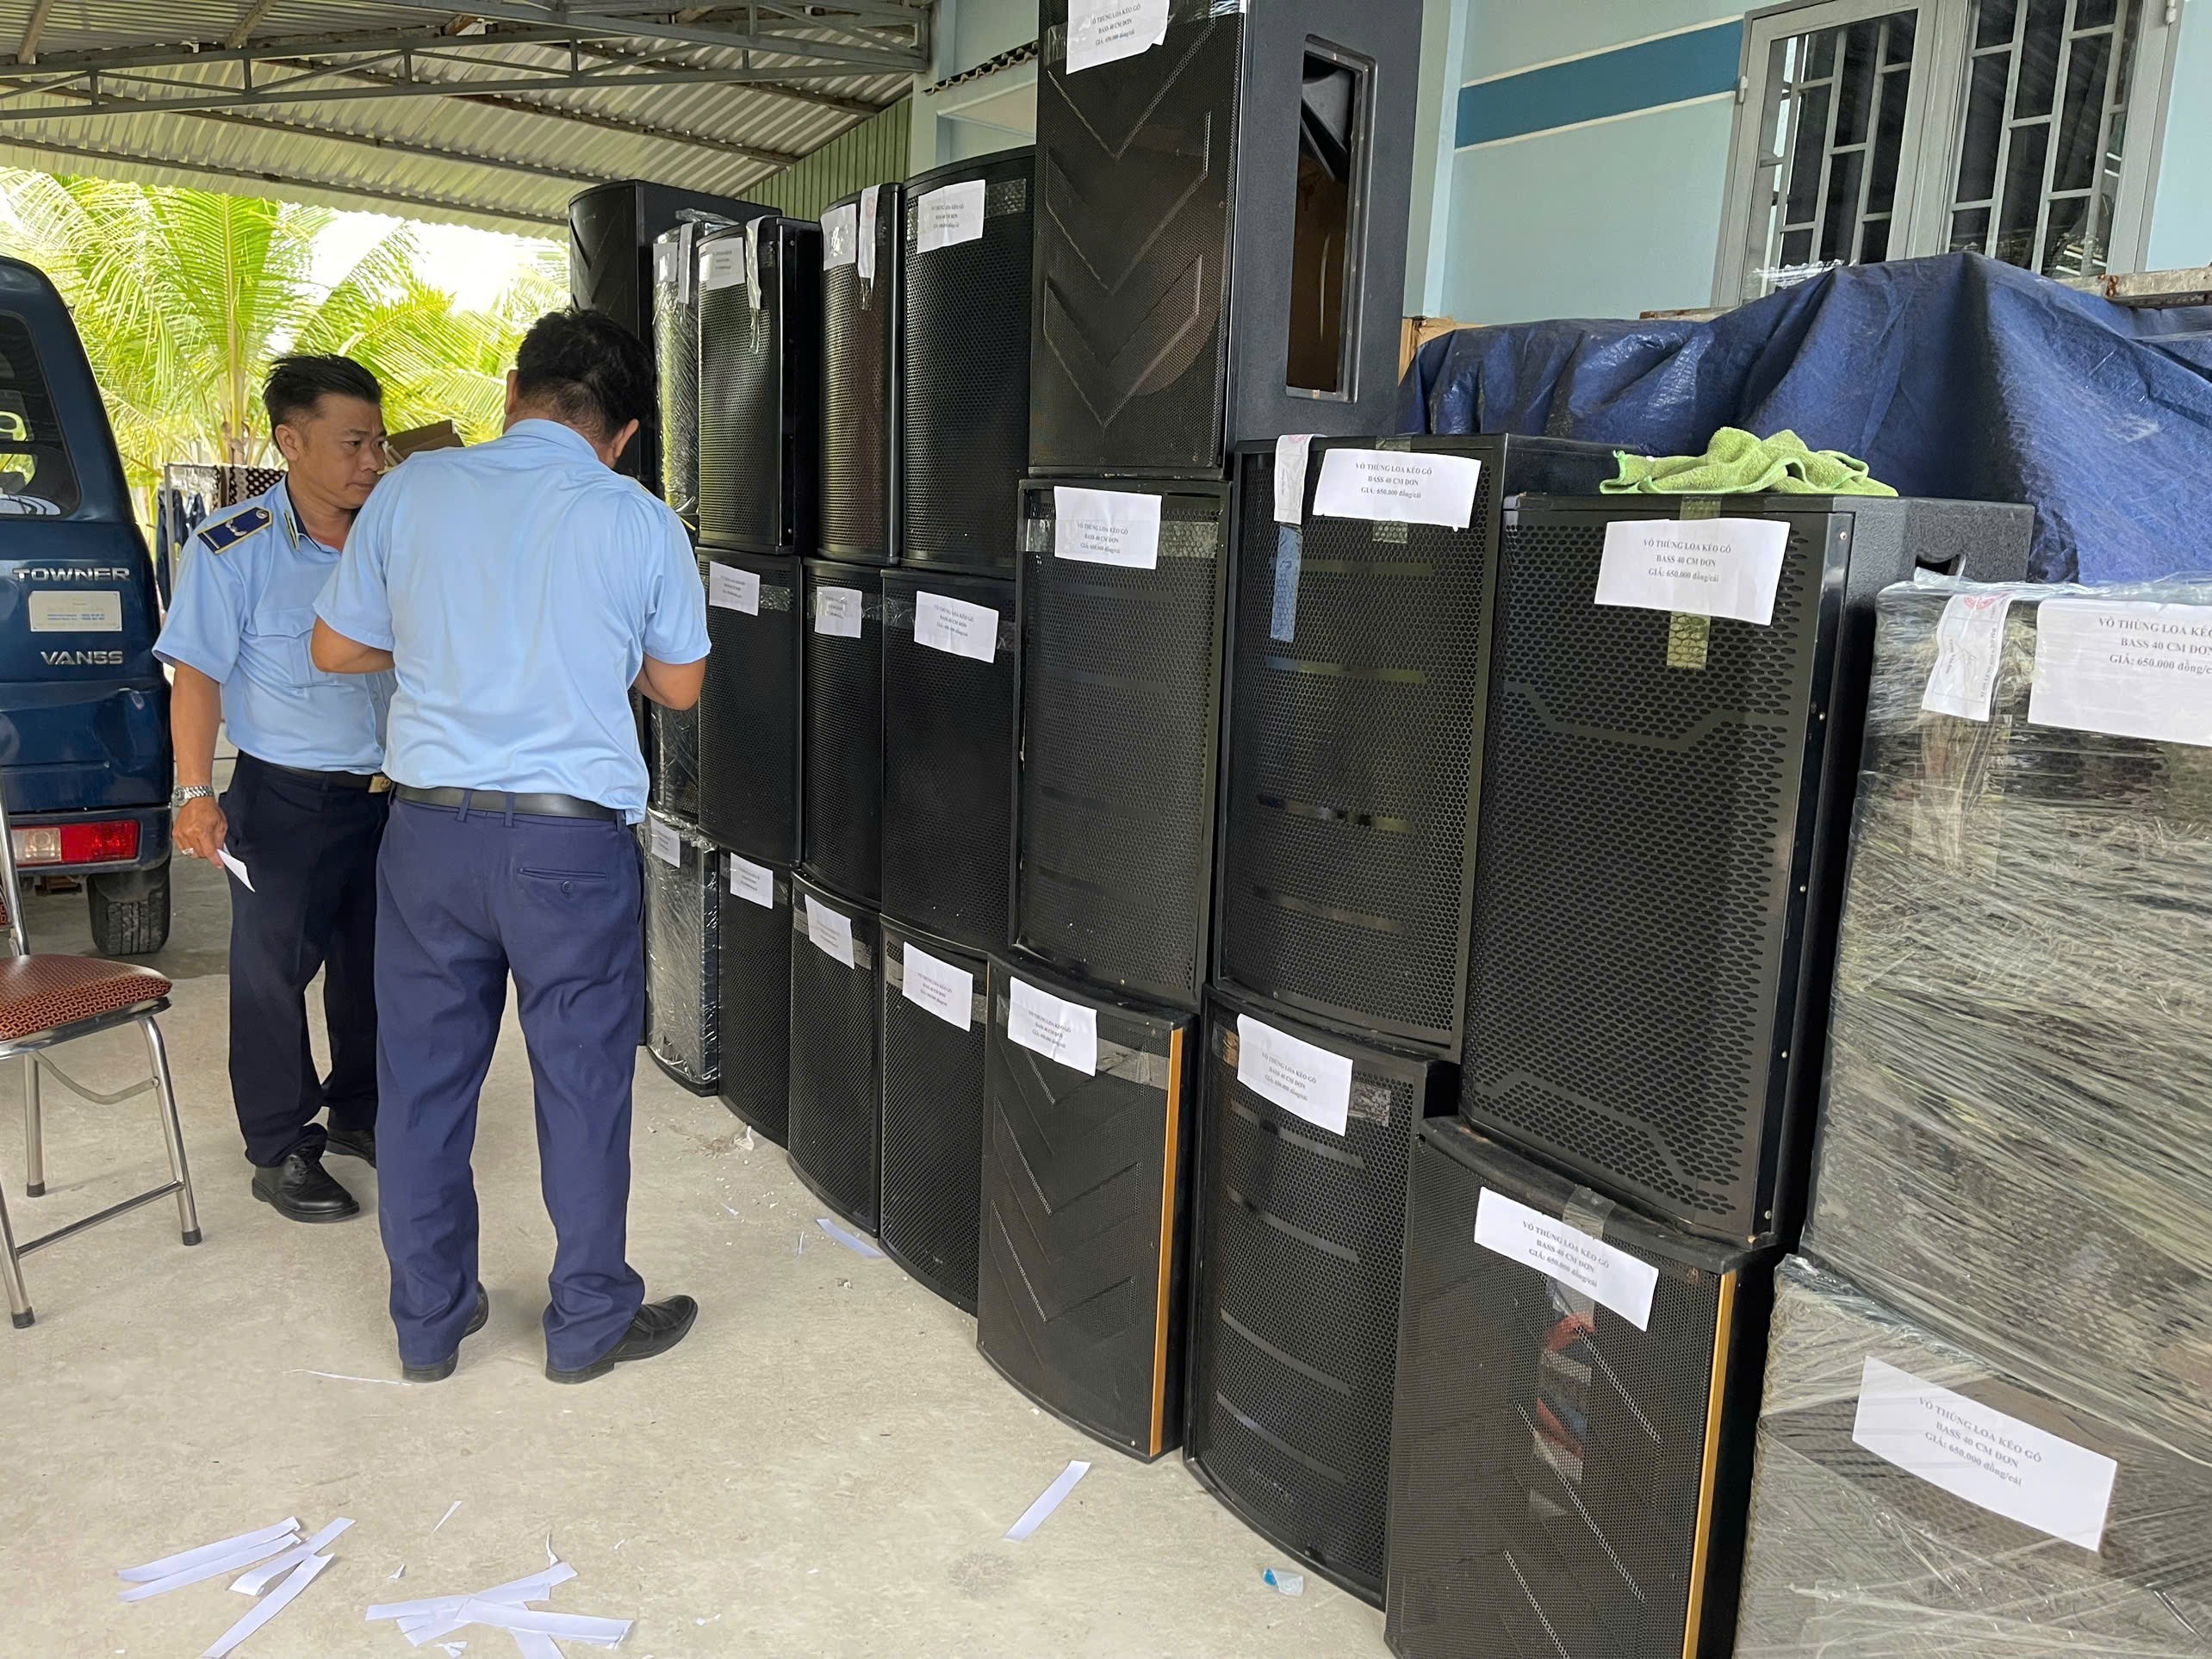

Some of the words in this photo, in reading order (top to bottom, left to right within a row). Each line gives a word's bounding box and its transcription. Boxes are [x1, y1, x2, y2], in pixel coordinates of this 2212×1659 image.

[1702, 544, 1718, 552] KÉO
[13, 568, 130, 582] TOWNER
[1667, 570, 1691, 579] 650.000
[2162, 624, 2186, 635] LOA
[2122, 637, 2149, 649] BASS
[2167, 643, 2185, 652] CM
[2137, 657, 2174, 669] 650.000
[1537, 1239, 1555, 1252] BASS
[1566, 1253, 1576, 1264] CM
[1564, 1240, 1579, 1252] LOA
[1581, 1247, 1596, 1261] KÉO
[1936, 1422, 1961, 1439] BASS
[1963, 1437, 1973, 1446] 40
[1976, 1442, 1992, 1456] CM
[1973, 1425, 1996, 1441] LOA
[1999, 1437, 2022, 1453] KÉO
[2025, 1450, 2041, 1463] GỖ
[1949, 1445, 1981, 1466] 650.000
